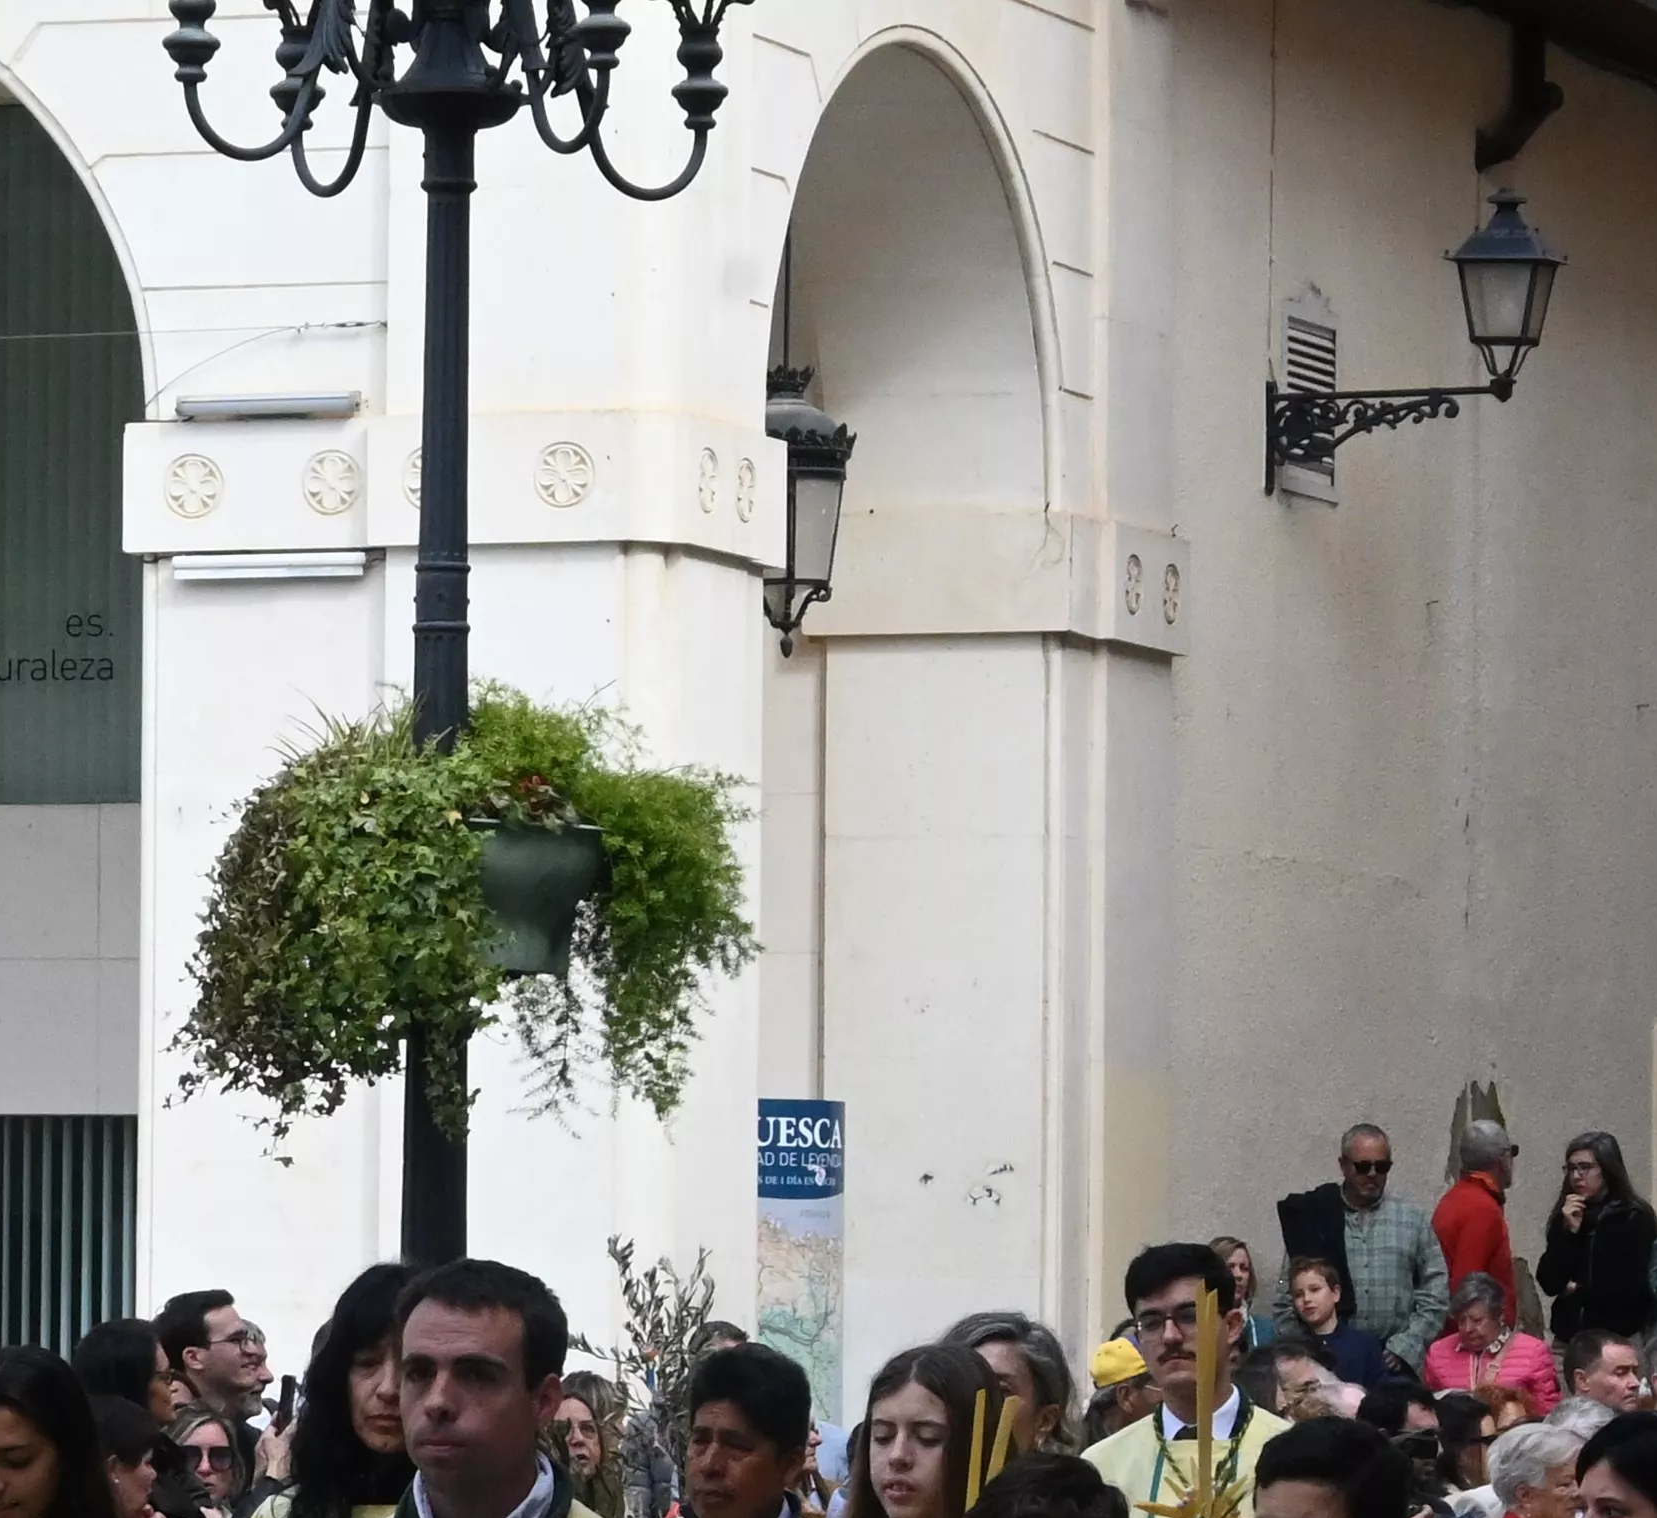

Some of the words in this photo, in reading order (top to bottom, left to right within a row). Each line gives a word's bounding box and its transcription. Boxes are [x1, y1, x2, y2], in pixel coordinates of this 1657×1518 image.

[65, 613, 114, 638] es.
[758, 1116, 843, 1149] UESCA
[779, 1152, 798, 1166] DE
